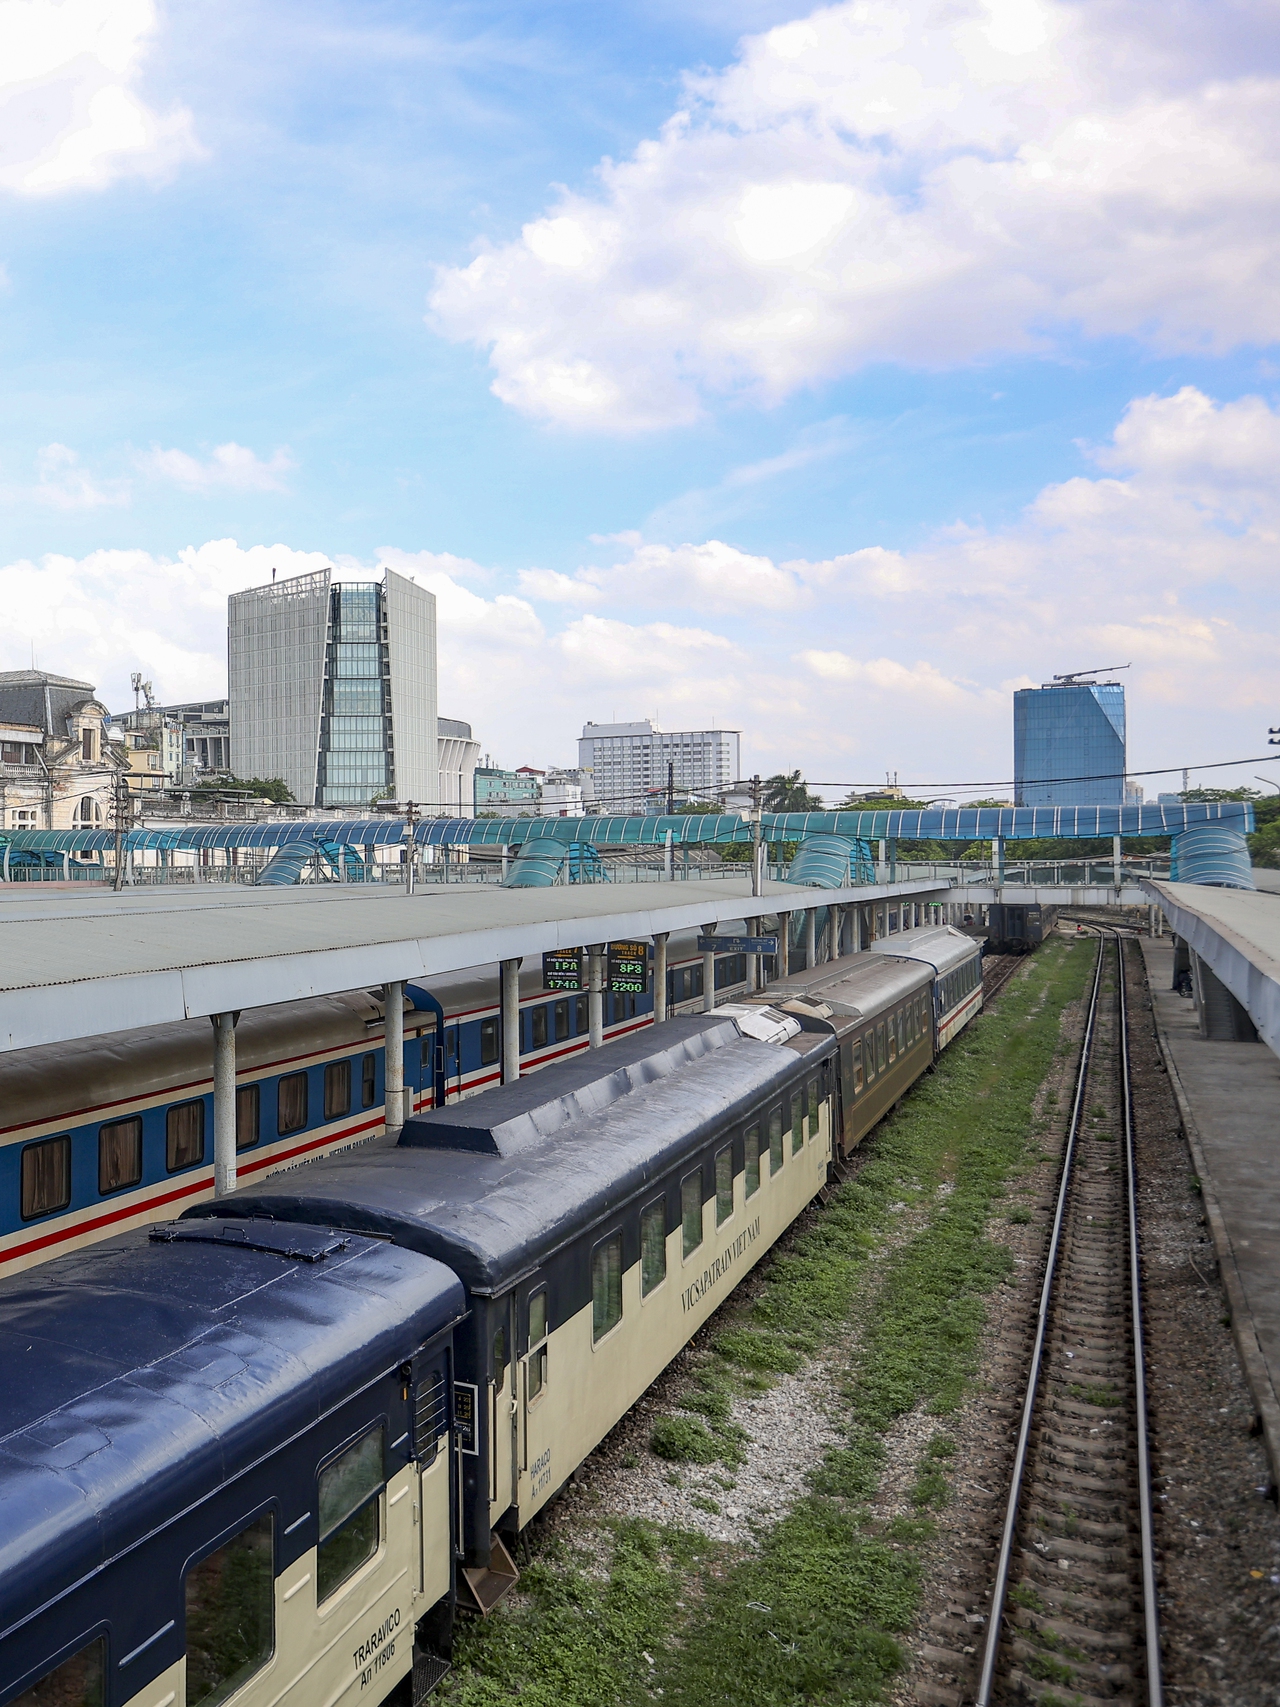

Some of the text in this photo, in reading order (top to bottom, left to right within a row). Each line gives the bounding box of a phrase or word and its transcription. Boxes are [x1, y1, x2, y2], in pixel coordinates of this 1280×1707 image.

[638, 945, 645, 956] 8
[612, 981, 642, 992] 2200
[747, 1216, 761, 1247] NAM
[353, 1608, 400, 1670] TRARAVICO
[360, 1639, 396, 1691] An 11806
